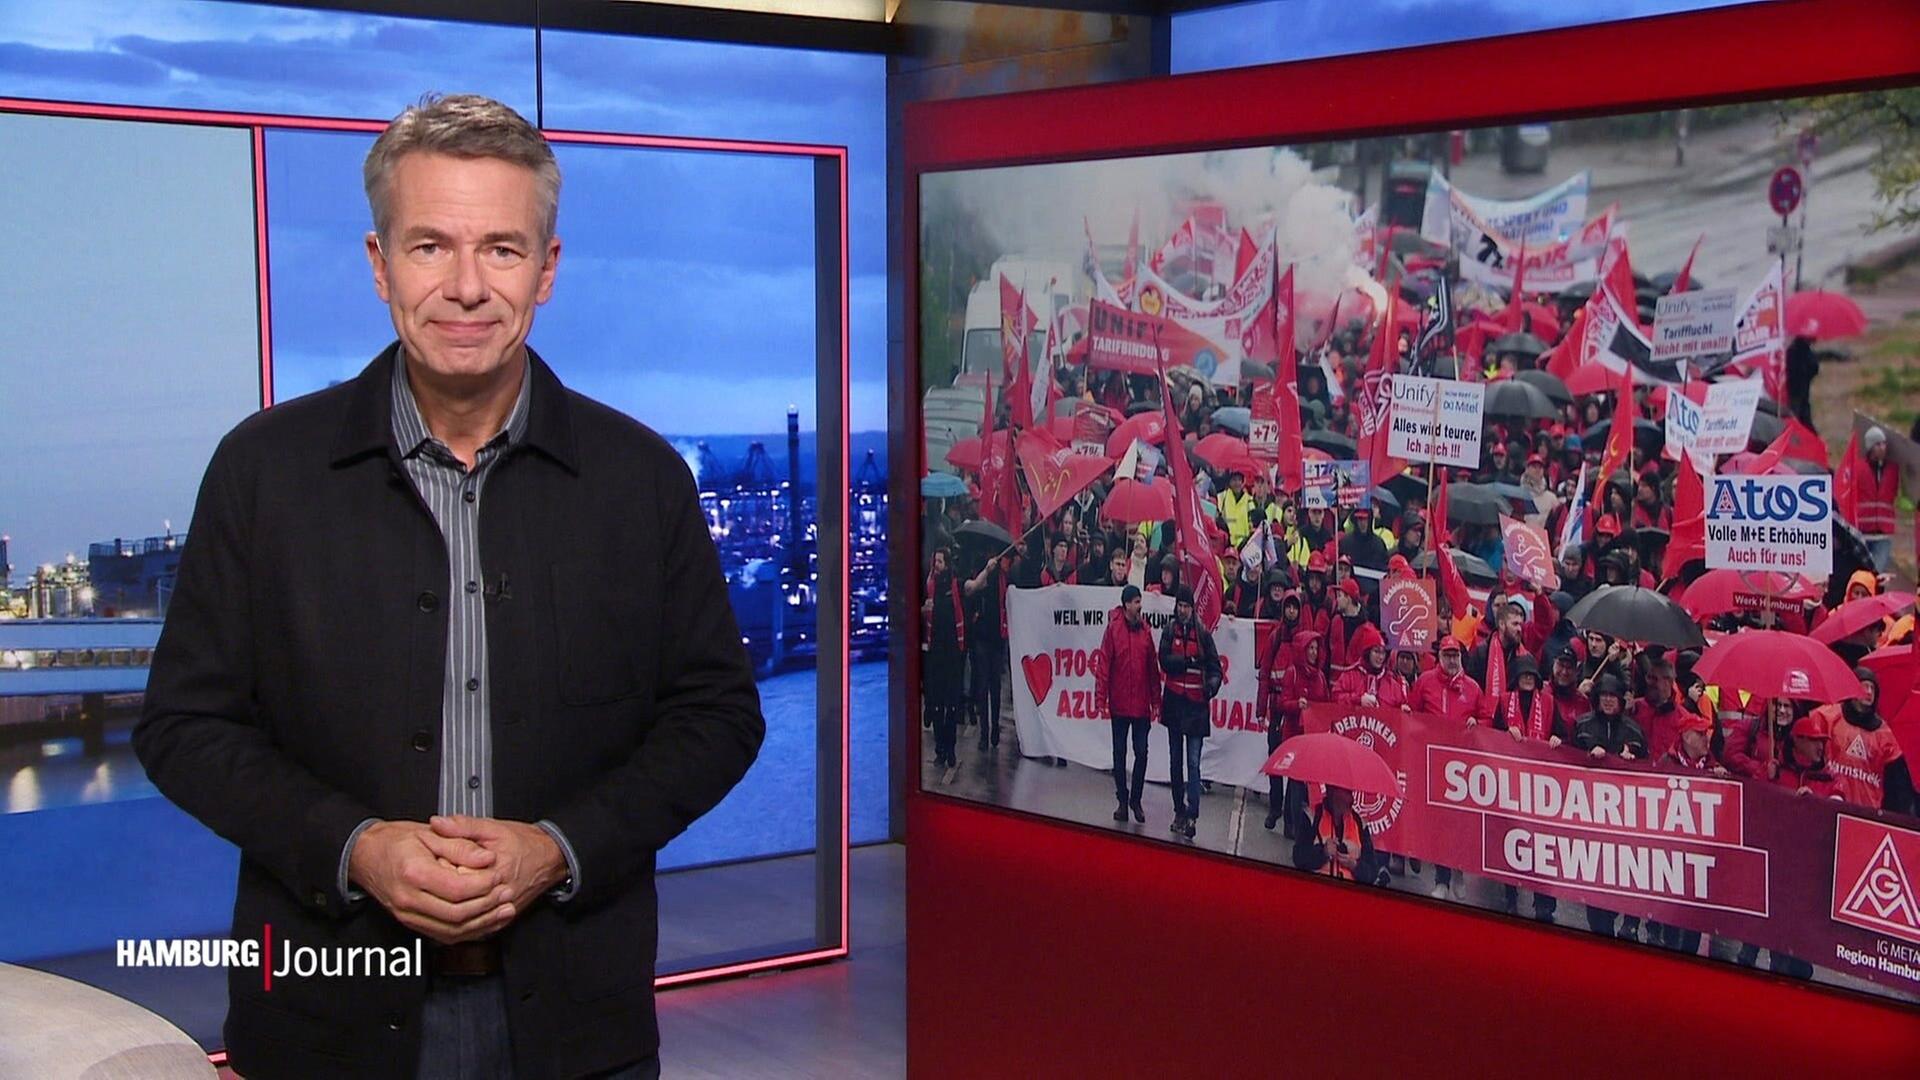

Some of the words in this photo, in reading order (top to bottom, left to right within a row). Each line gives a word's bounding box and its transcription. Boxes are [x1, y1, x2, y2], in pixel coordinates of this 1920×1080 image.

[1663, 323, 1713, 339] Tarifflucht
[1394, 381, 1434, 407] Unify
[1393, 417, 1417, 434] Alles
[1444, 424, 1477, 442] teurer.
[1406, 438, 1421, 453] Ich
[1708, 524, 1737, 542] Volle
[1740, 525, 1766, 543] M+E
[1769, 526, 1827, 550] Erhöhung
[1728, 546, 1757, 564] Auch
[1761, 547, 1777, 566] für
[1781, 550, 1807, 566] uns!
[1734, 594, 1758, 606] Werk
[1760, 597, 1800, 613] Hmburg
[1053, 609, 1080, 626] WEIL
[1083, 610, 1103, 626] WIR
[1335, 715, 1357, 734] DER
[1361, 715, 1397, 747] ANKER
[1444, 760, 1722, 837] SOLIDARITÄT
[1503, 828, 1716, 900] GEWINNT
[1836, 944, 1876, 968] Region
[1877, 939, 1889, 956] IG
